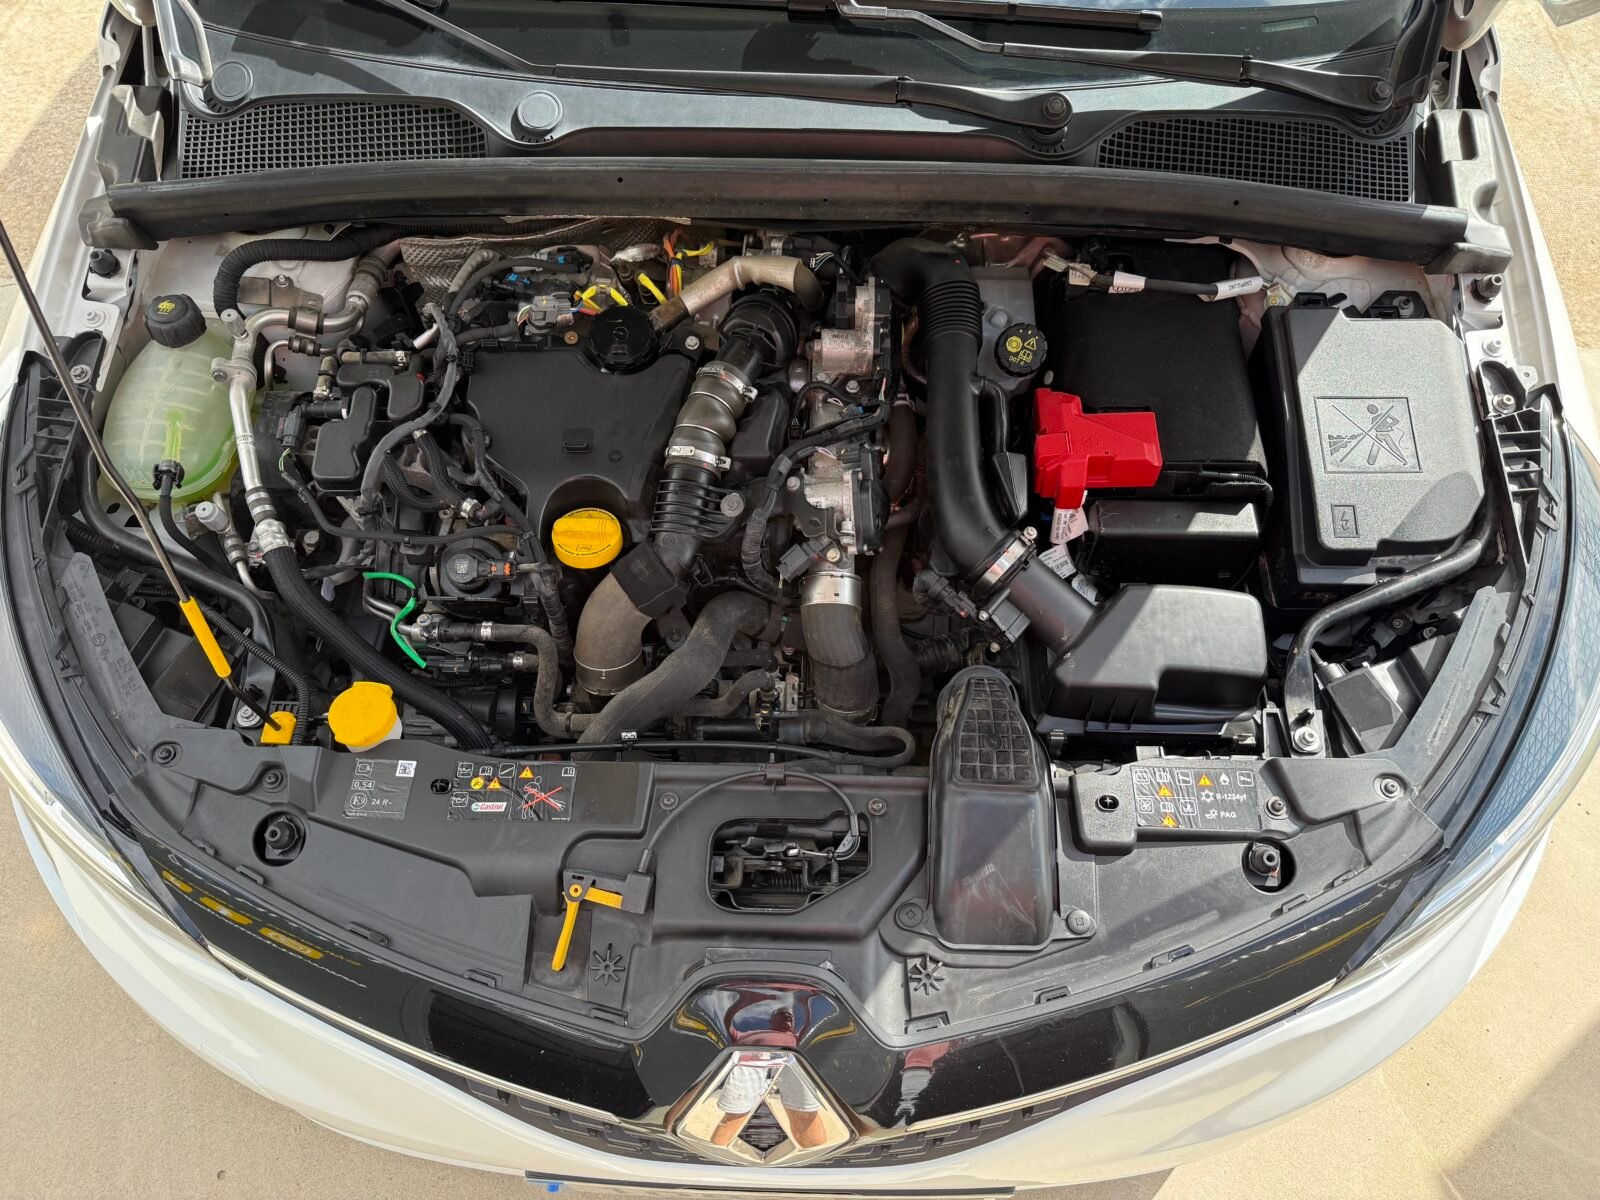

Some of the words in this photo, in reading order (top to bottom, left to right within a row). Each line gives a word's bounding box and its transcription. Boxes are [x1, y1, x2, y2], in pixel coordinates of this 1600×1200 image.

[1009, 355, 1020, 364] DOT
[371, 798, 380, 806] 24
[1216, 793, 1247, 802] R-1234yf
[480, 802, 505, 811] Castrol
[1220, 811, 1237, 819] PAG
